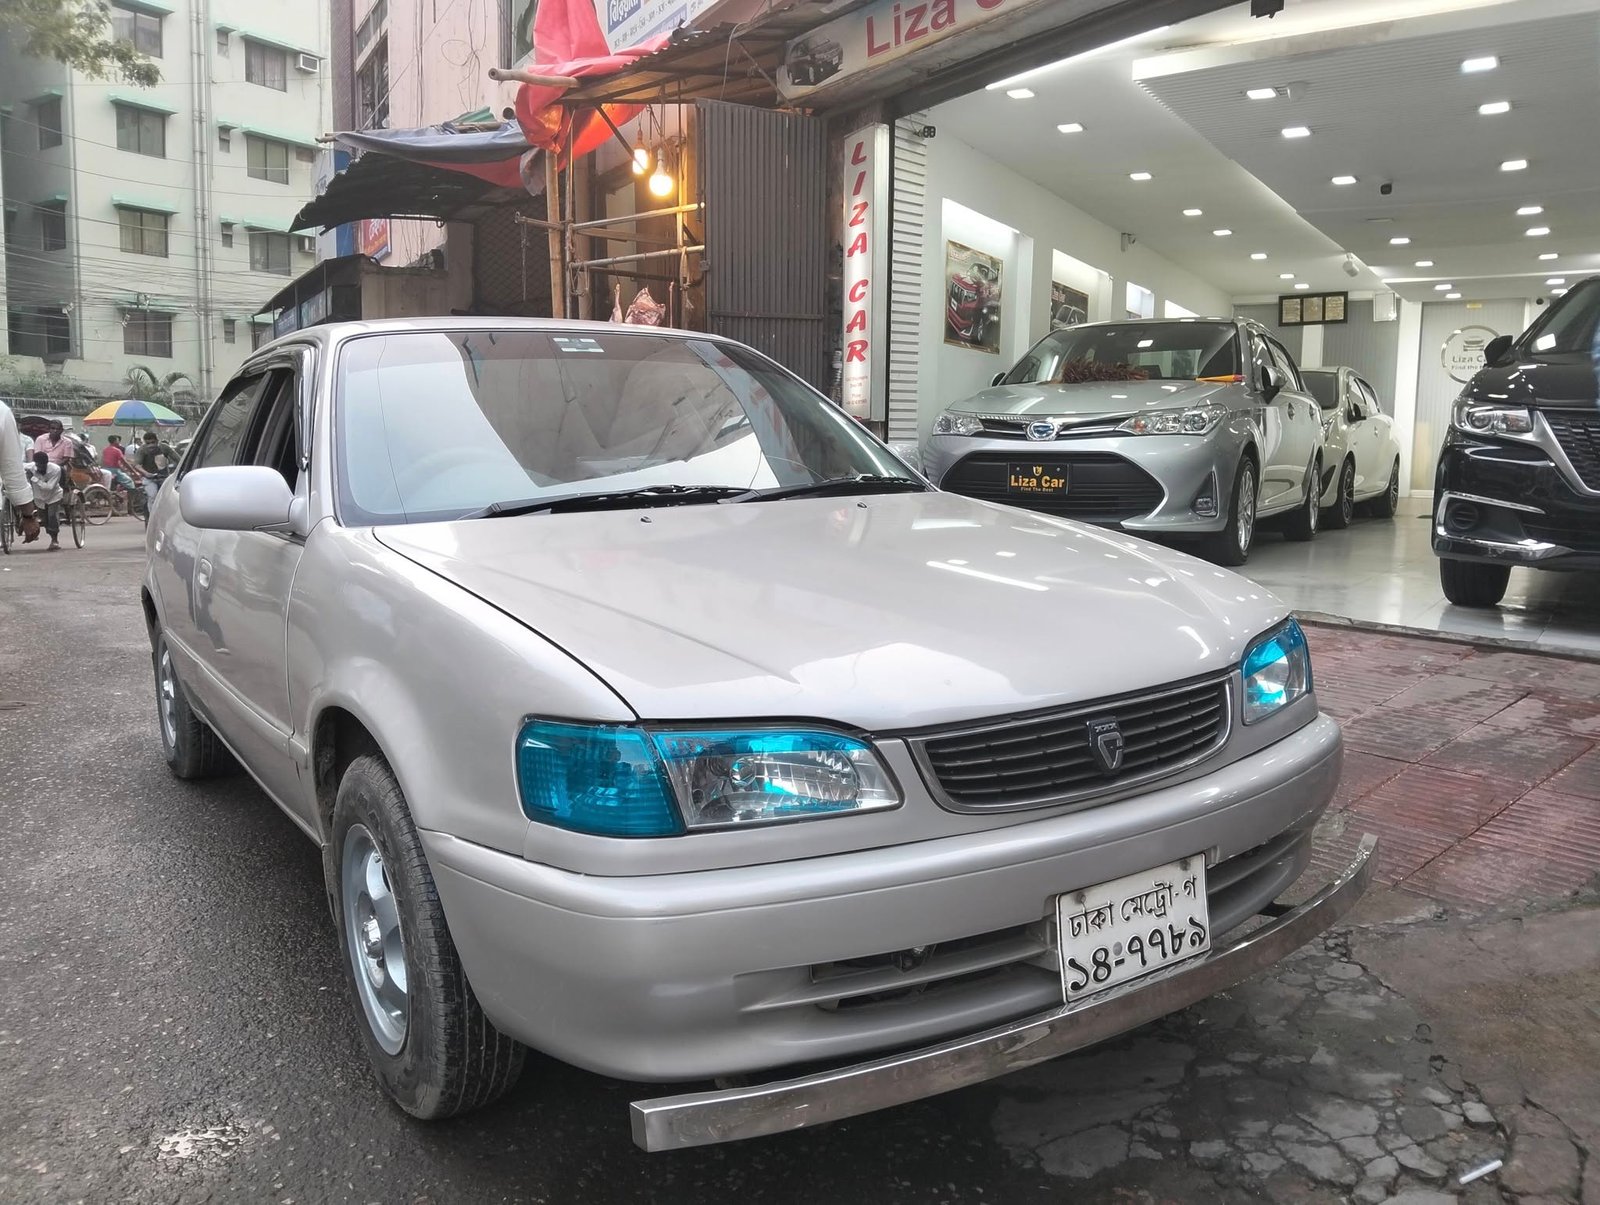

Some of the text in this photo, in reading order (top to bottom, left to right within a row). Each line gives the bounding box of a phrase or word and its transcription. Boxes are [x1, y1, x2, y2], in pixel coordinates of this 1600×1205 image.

[866, 0, 957, 58] Liza
[847, 141, 868, 257] LIZA
[846, 279, 869, 363] CAR
[1011, 475, 1065, 488] Liza Car
[1068, 900, 1114, 938] ঢাকা
[1067, 916, 1207, 991] ১৪-৭৭৮৯
